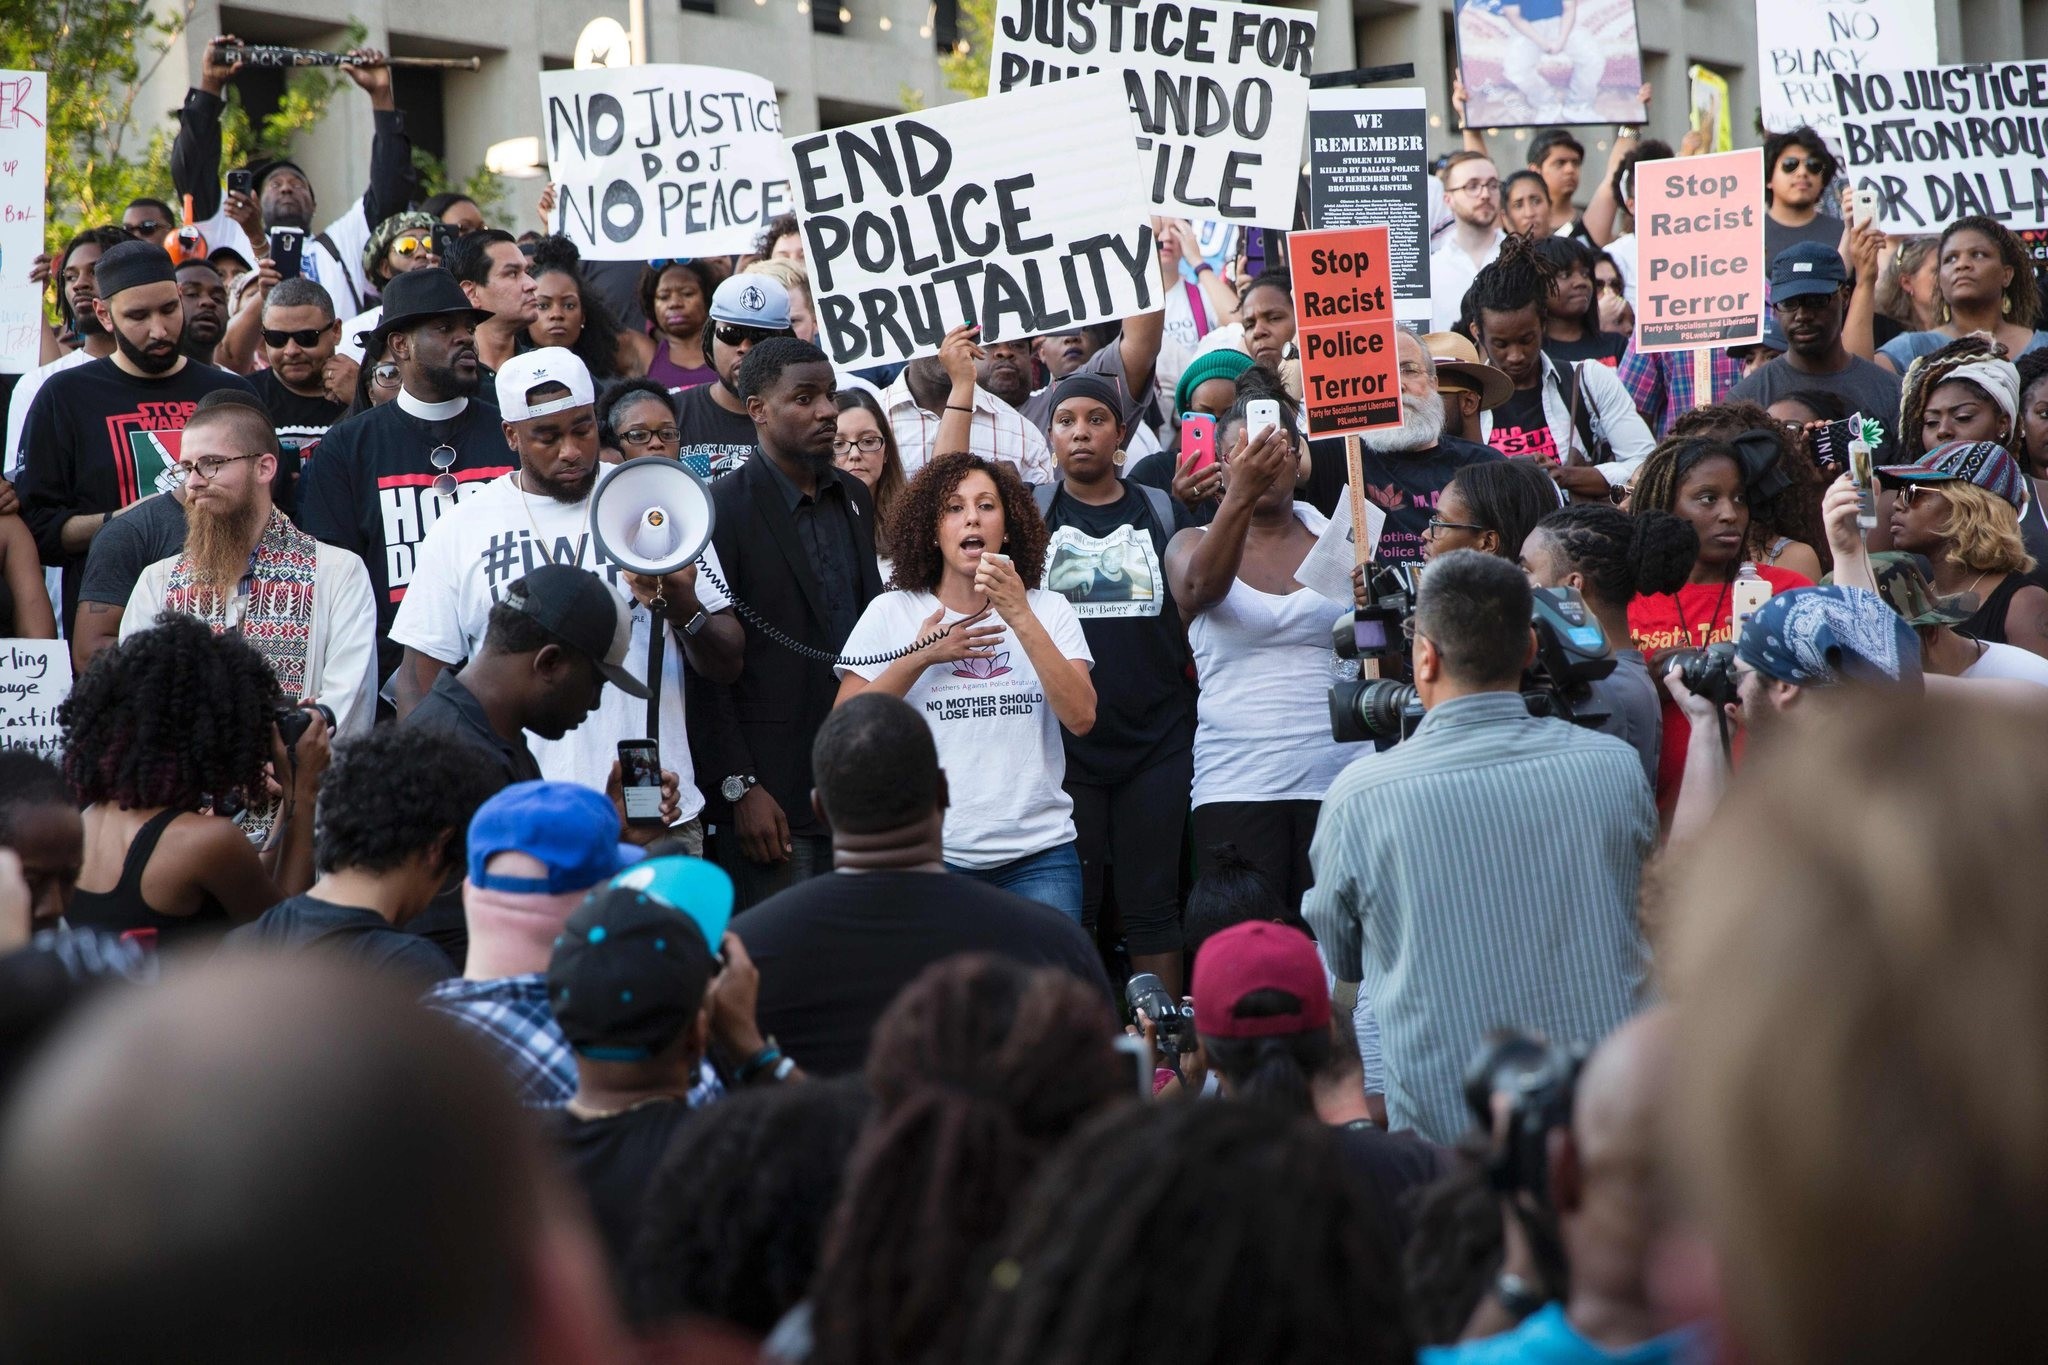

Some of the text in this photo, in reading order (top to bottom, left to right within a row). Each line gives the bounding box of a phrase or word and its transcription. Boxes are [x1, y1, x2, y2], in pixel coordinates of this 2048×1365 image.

[1001, 0, 1316, 77] JUSTICE FOR
[1828, 11, 1879, 41] NO
[225, 51, 283, 66] BLACK
[1771, 49, 1868, 77] BLACK
[1833, 63, 2048, 116] NO JUSTICE
[549, 87, 783, 162] NO JUSTICE
[1353, 114, 1382, 129] WE
[1315, 136, 1424, 152] REMEMBER
[1966, 117, 2048, 159] ROU
[792, 120, 953, 213] END
[1665, 174, 1738, 199] Stop
[559, 178, 790, 246] NO PEACE
[1651, 204, 1753, 237] Racist
[804, 173, 1054, 292] POLICE
[1311, 249, 1369, 278] Stop
[1650, 254, 1748, 281] Police
[817, 225, 1153, 364] BRUTALITY
[1304, 285, 1385, 318] Racist
[1649, 292, 1749, 317] Terror
[1644, 325, 1662, 333] Party
[1675, 321, 1708, 331] Socialism
[1722, 316, 1756, 326] Liberation
[1681, 331, 1720, 340] PSLweb.org
[1307, 331, 1383, 360] Police
[1310, 373, 1388, 400] Terror
[1310, 410, 1323, 418] Party
[1332, 406, 1357, 415] Socialism
[1367, 400, 1396, 410] Liberation
[1337, 416, 1368, 426] PSLweb.org
[138, 416, 191, 431] WAR
[680, 443, 752, 458] BLACK LIVES
[1380, 531, 1425, 543] others
[1697, 622, 1732, 645] Tau
[931, 679, 1038, 693] Mothers Against Police Brutality
[926, 694, 1043, 711] NO MOTHER SHOULD
[939, 704, 1033, 721] LOSE HER CHILD
[0, 734, 60, 752] Height
